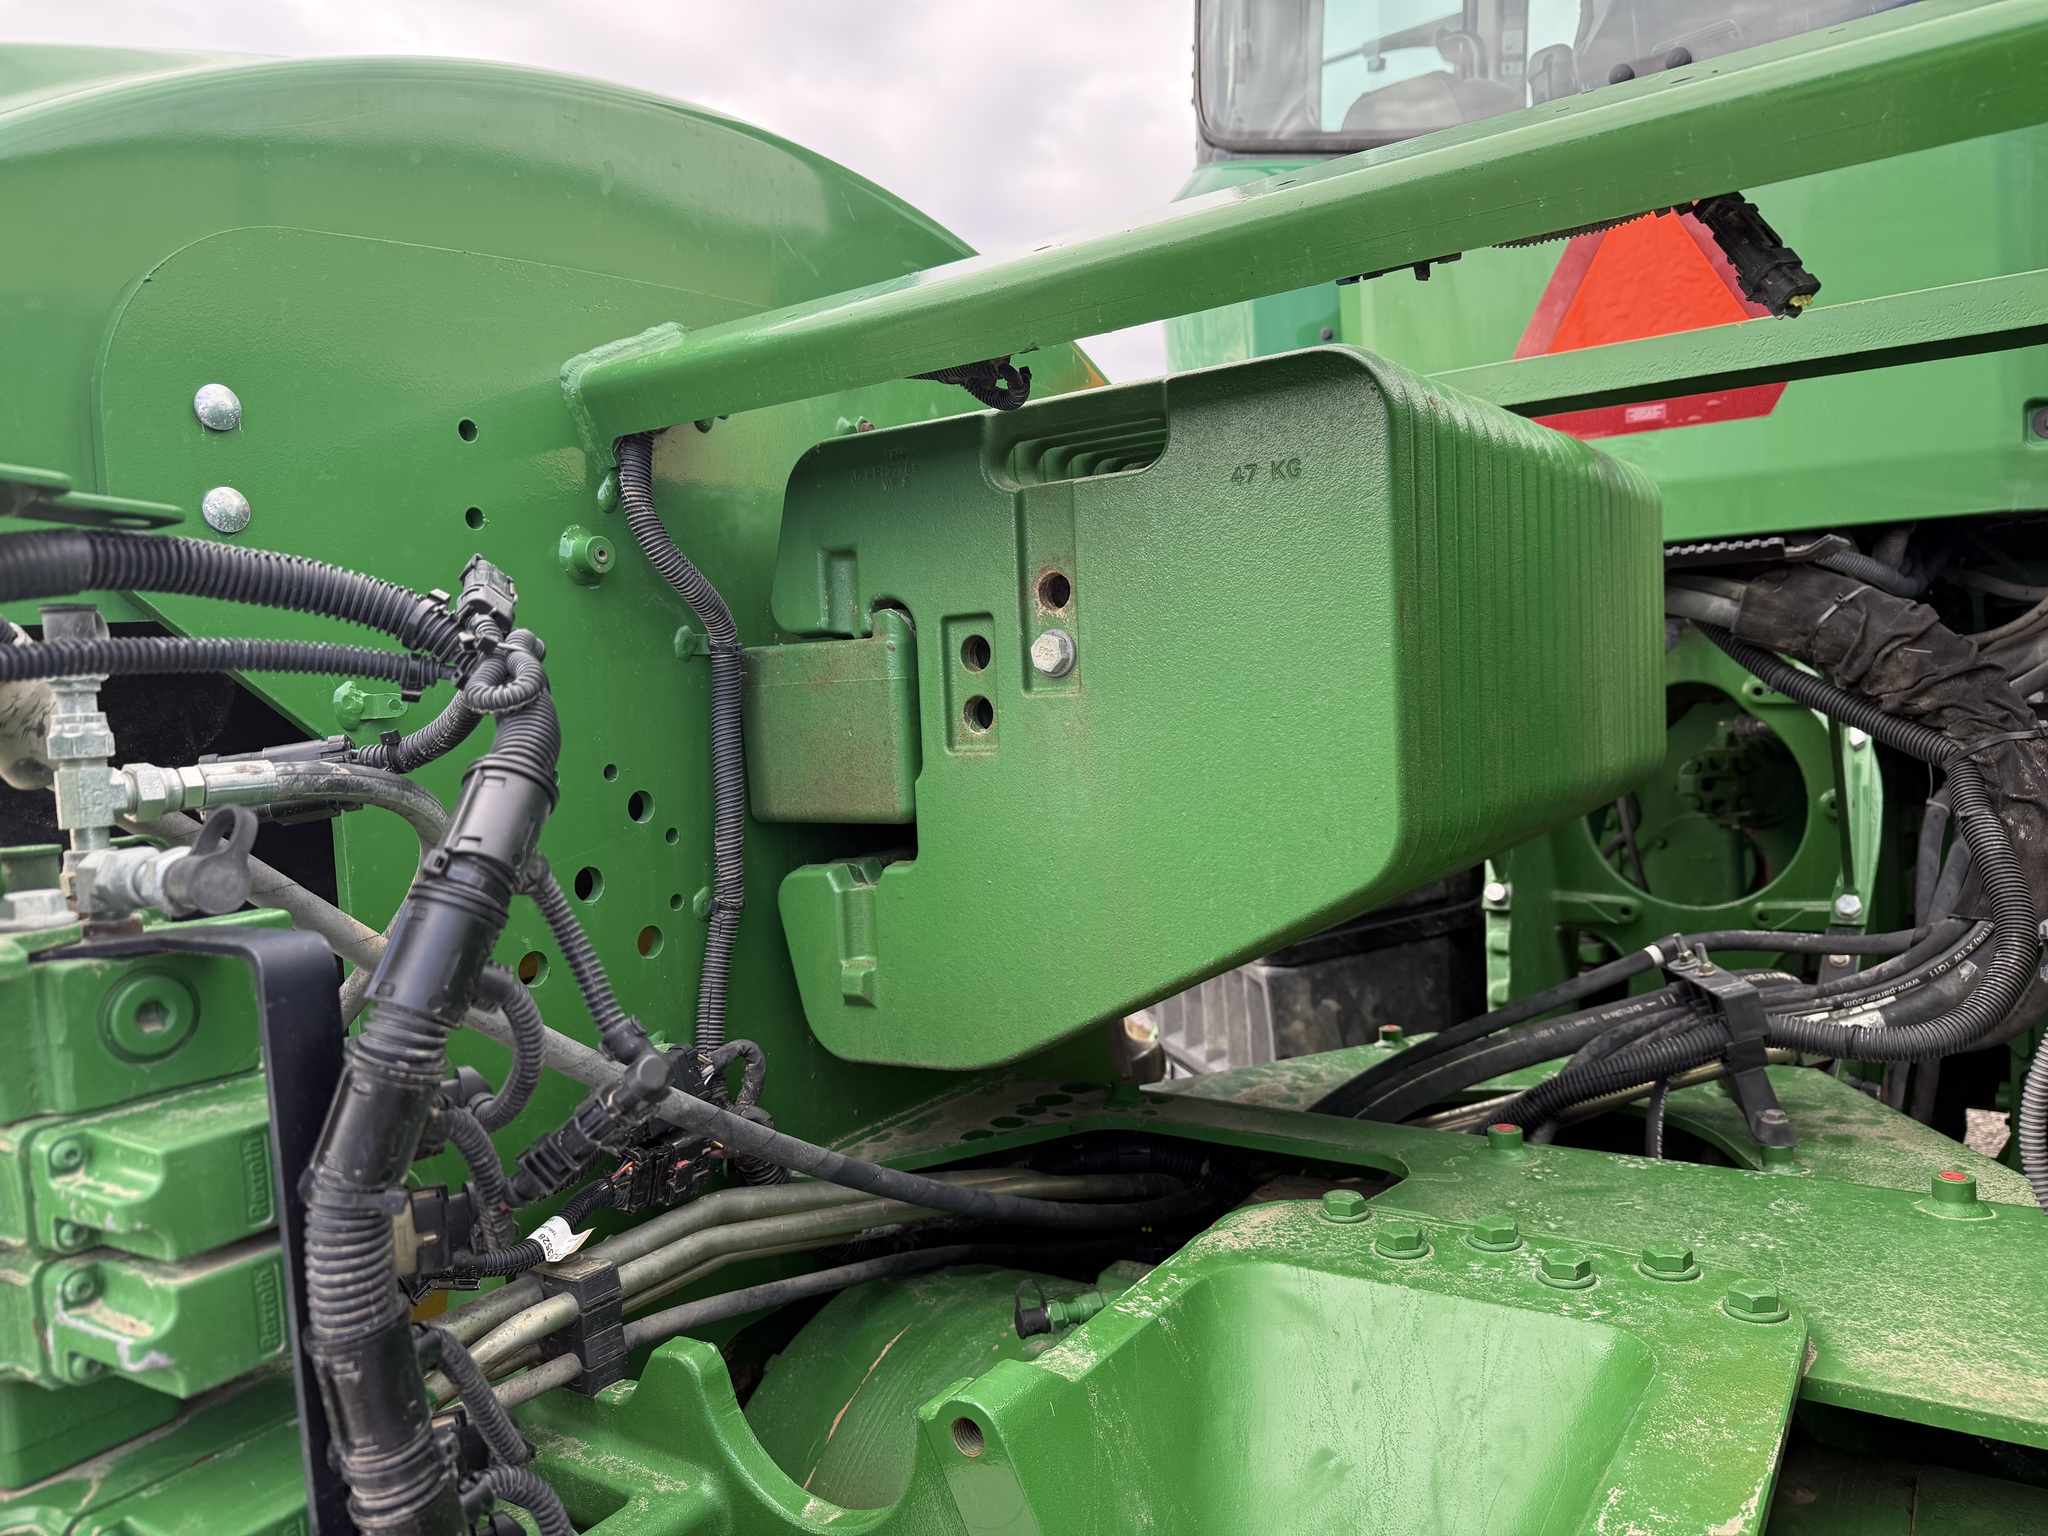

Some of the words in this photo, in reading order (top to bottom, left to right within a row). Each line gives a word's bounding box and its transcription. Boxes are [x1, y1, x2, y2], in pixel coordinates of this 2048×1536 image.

[1230, 463, 1258, 486] 47
[1271, 457, 1303, 482] KG
[1843, 977, 1921, 1008] www.parker.com
[243, 1138, 269, 1219] Rexroth
[254, 1264, 281, 1350] Rexroth
